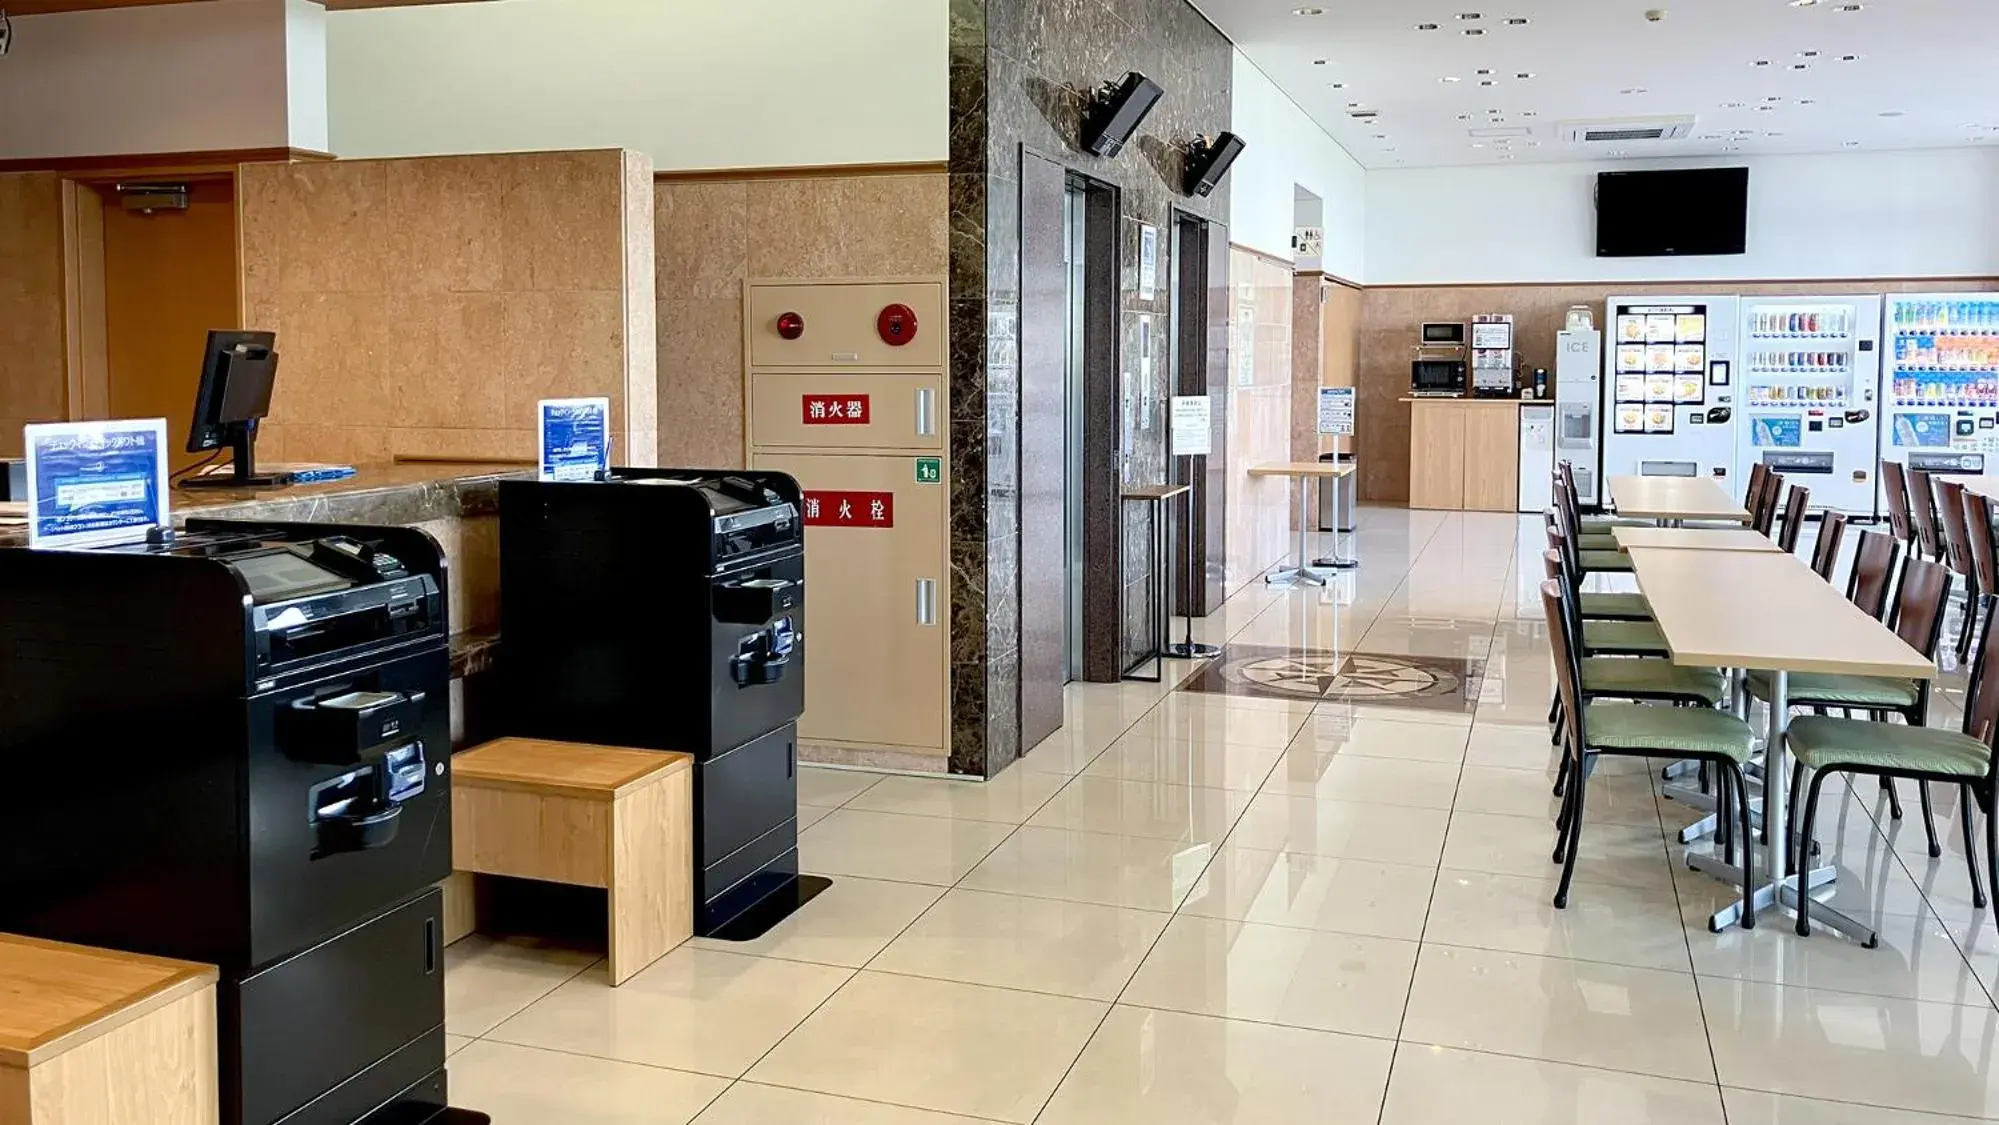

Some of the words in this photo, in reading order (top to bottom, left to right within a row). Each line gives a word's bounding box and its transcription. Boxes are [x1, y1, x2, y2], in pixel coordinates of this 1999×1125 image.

[1566, 341, 1589, 353] ICE
[809, 400, 863, 419] 消火器
[806, 498, 885, 521] 消火栓
